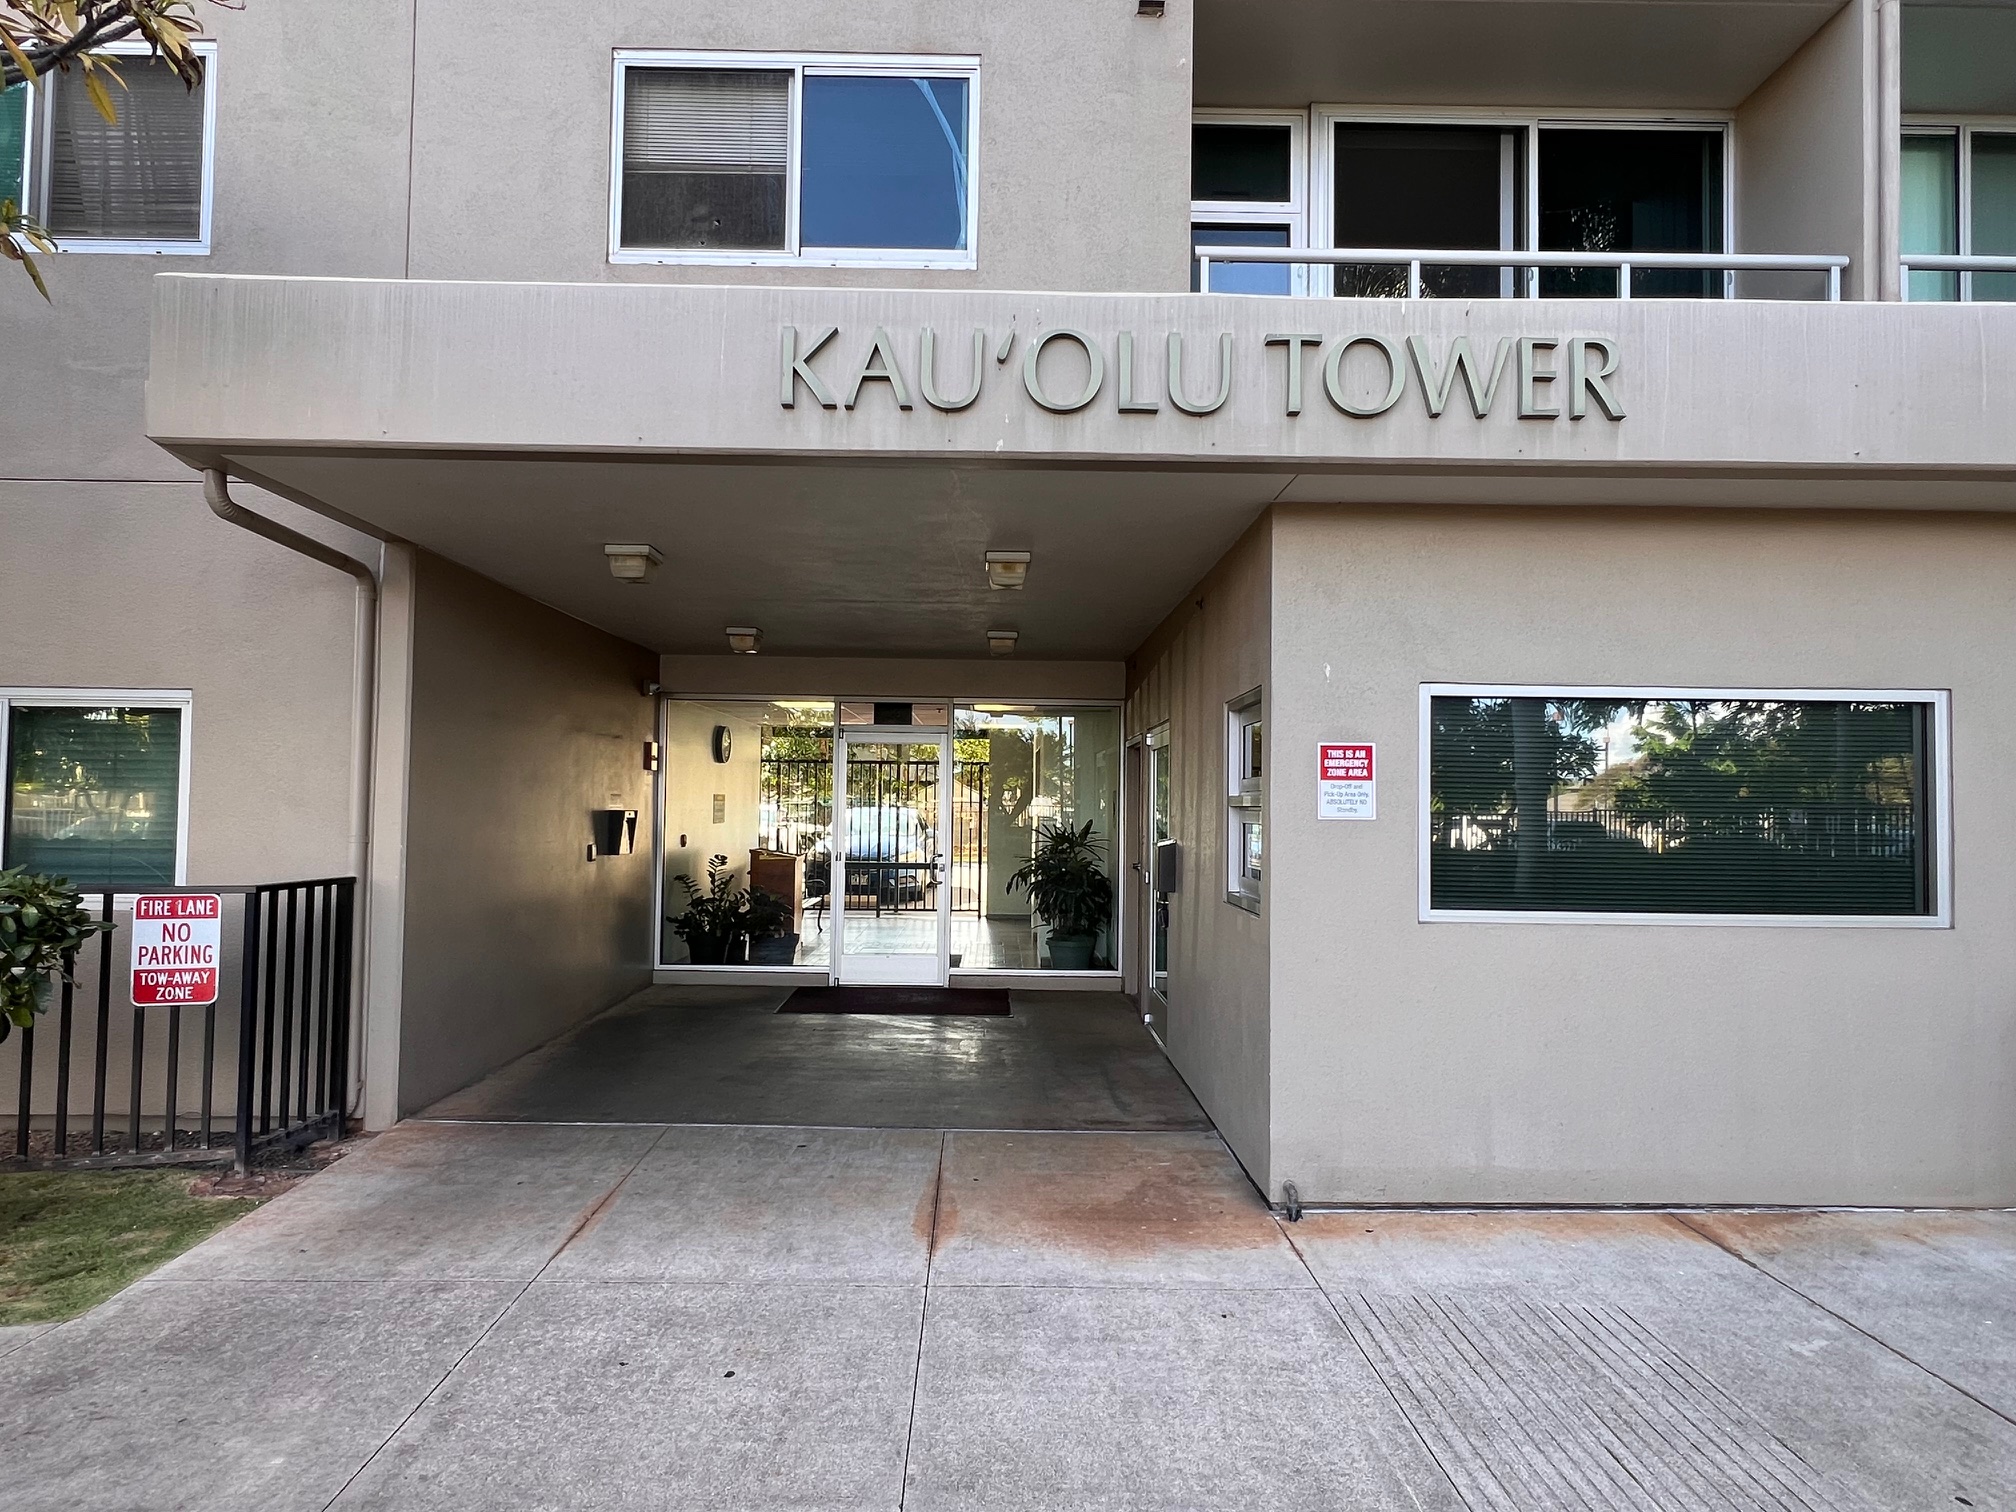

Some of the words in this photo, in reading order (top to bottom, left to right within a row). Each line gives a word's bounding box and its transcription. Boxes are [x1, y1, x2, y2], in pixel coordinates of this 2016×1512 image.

[1264, 333, 1627, 421] TOWER
[1327, 750, 1344, 758] THIS
[1345, 750, 1353, 758] IS
[1355, 750, 1366, 758] AN
[1324, 759, 1369, 767] EMERGENCY
[1327, 768, 1346, 776] ZONE
[1348, 768, 1368, 776] AREA
[140, 899, 172, 916] FIRE
[177, 899, 214, 915] LANE
[162, 922, 191, 943] NO
[138, 944, 213, 966] PARKING
[140, 971, 210, 986] TOW-AWAY
[156, 986, 193, 1001] ZONE
